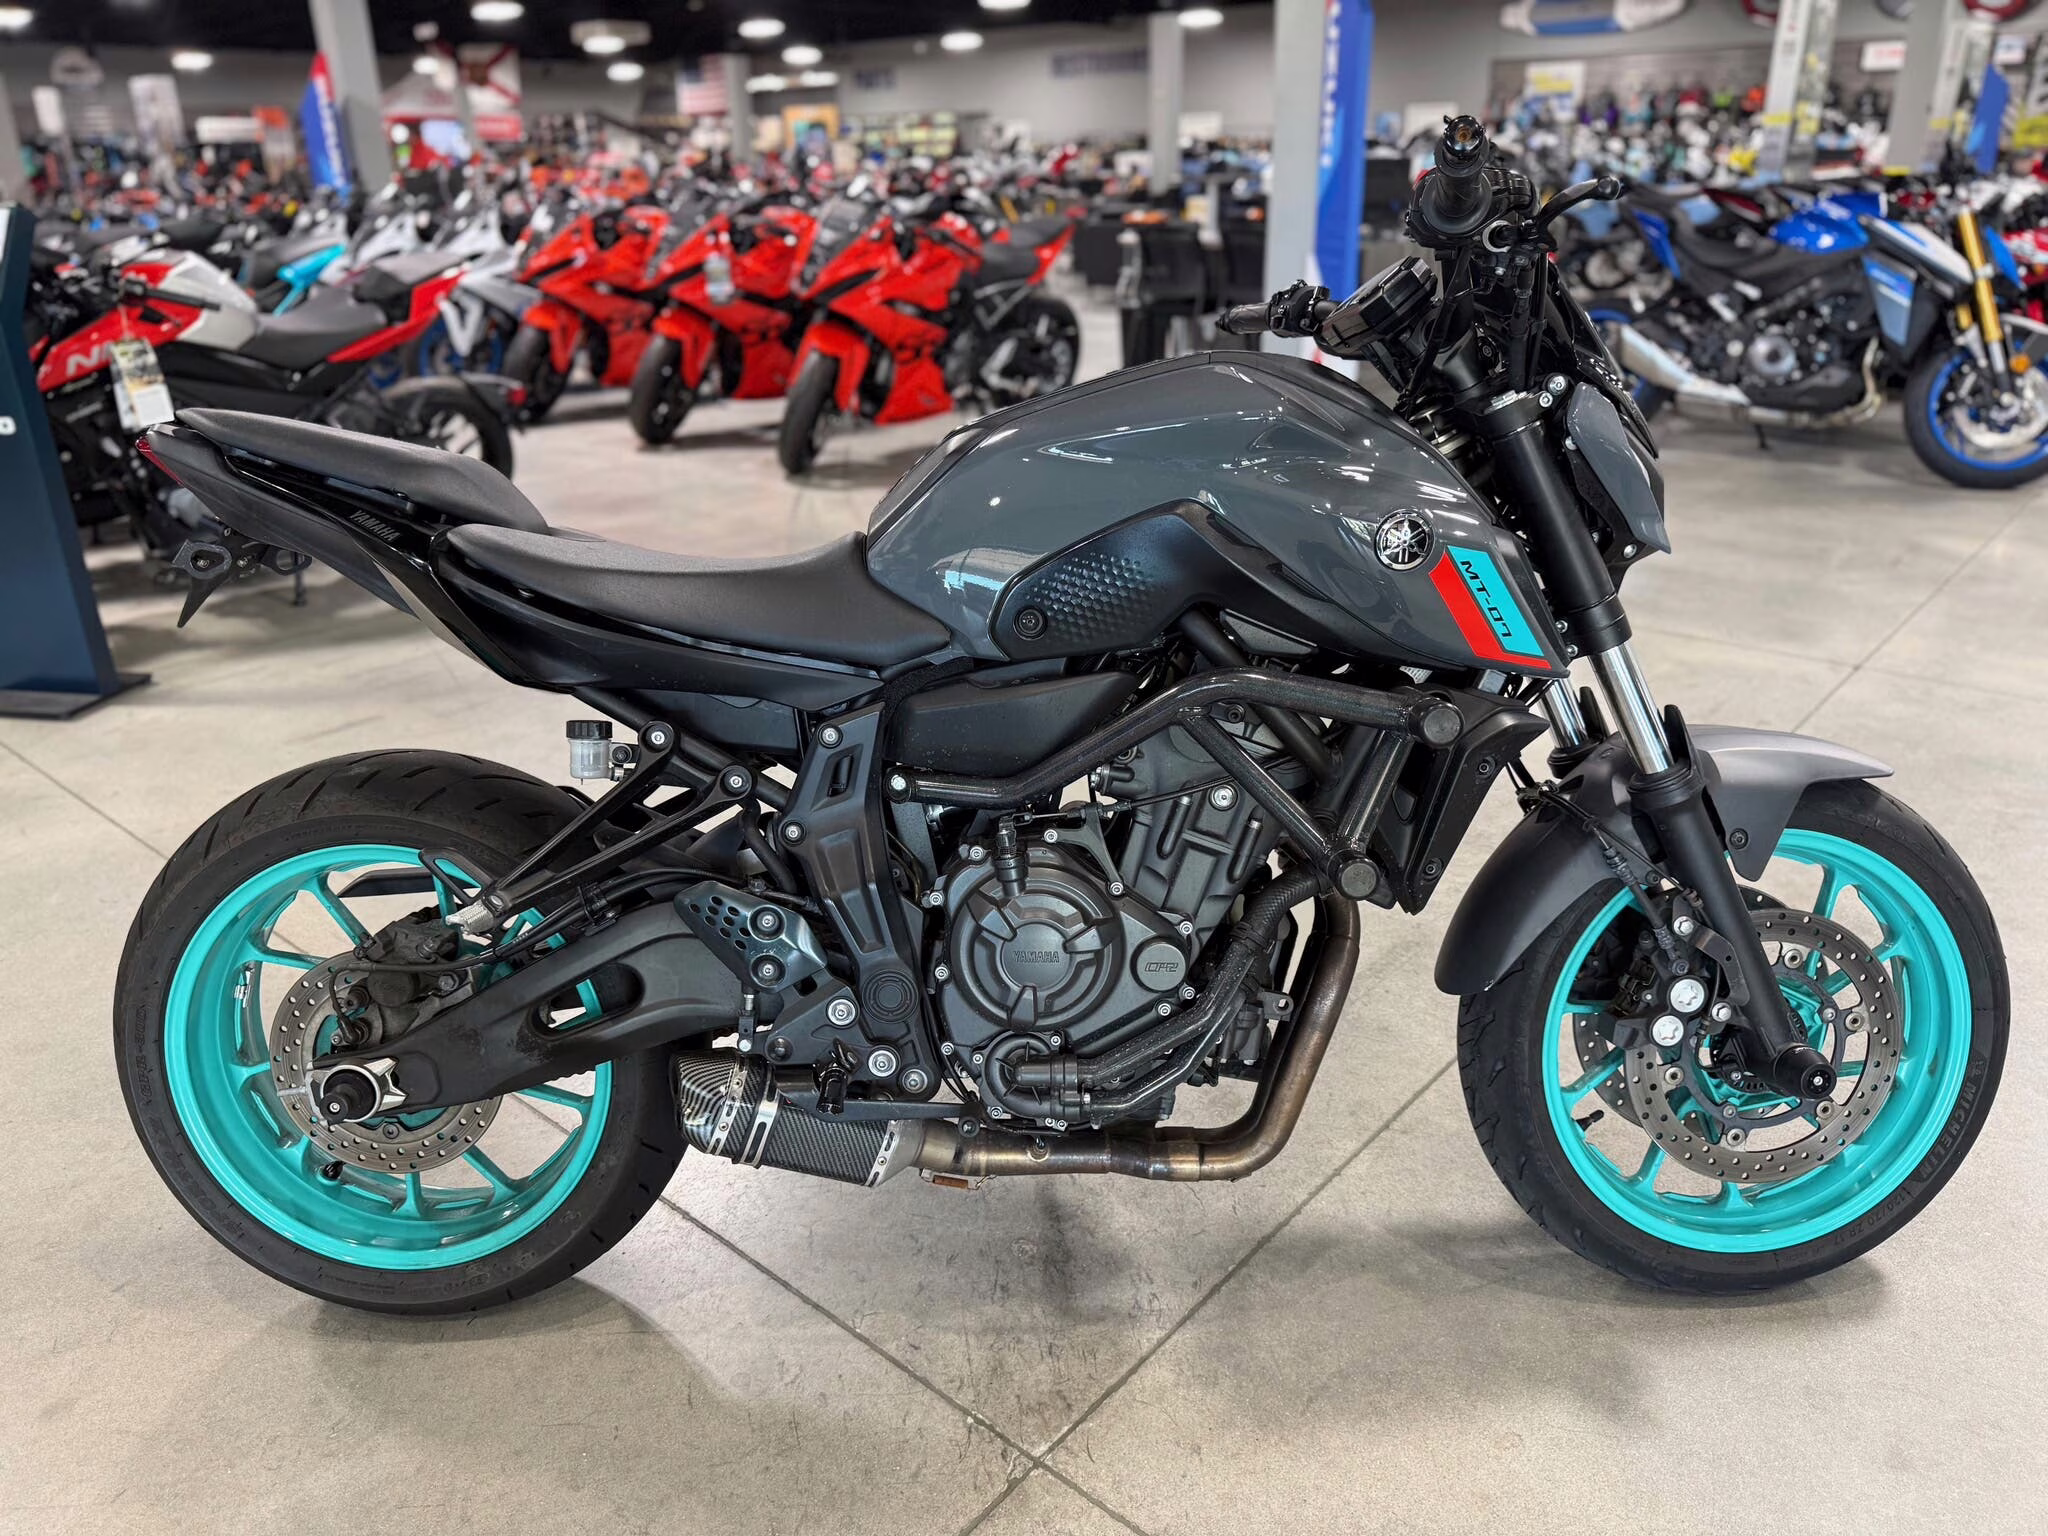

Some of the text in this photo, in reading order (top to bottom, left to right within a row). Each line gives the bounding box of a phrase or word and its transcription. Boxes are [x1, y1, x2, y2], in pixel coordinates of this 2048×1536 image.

[348, 509, 402, 542] YAMAHA
[1460, 561, 1512, 637] MT-07
[1013, 951, 1060, 963] YAMAHA
[1919, 1081, 1977, 1179] MICHELIN
